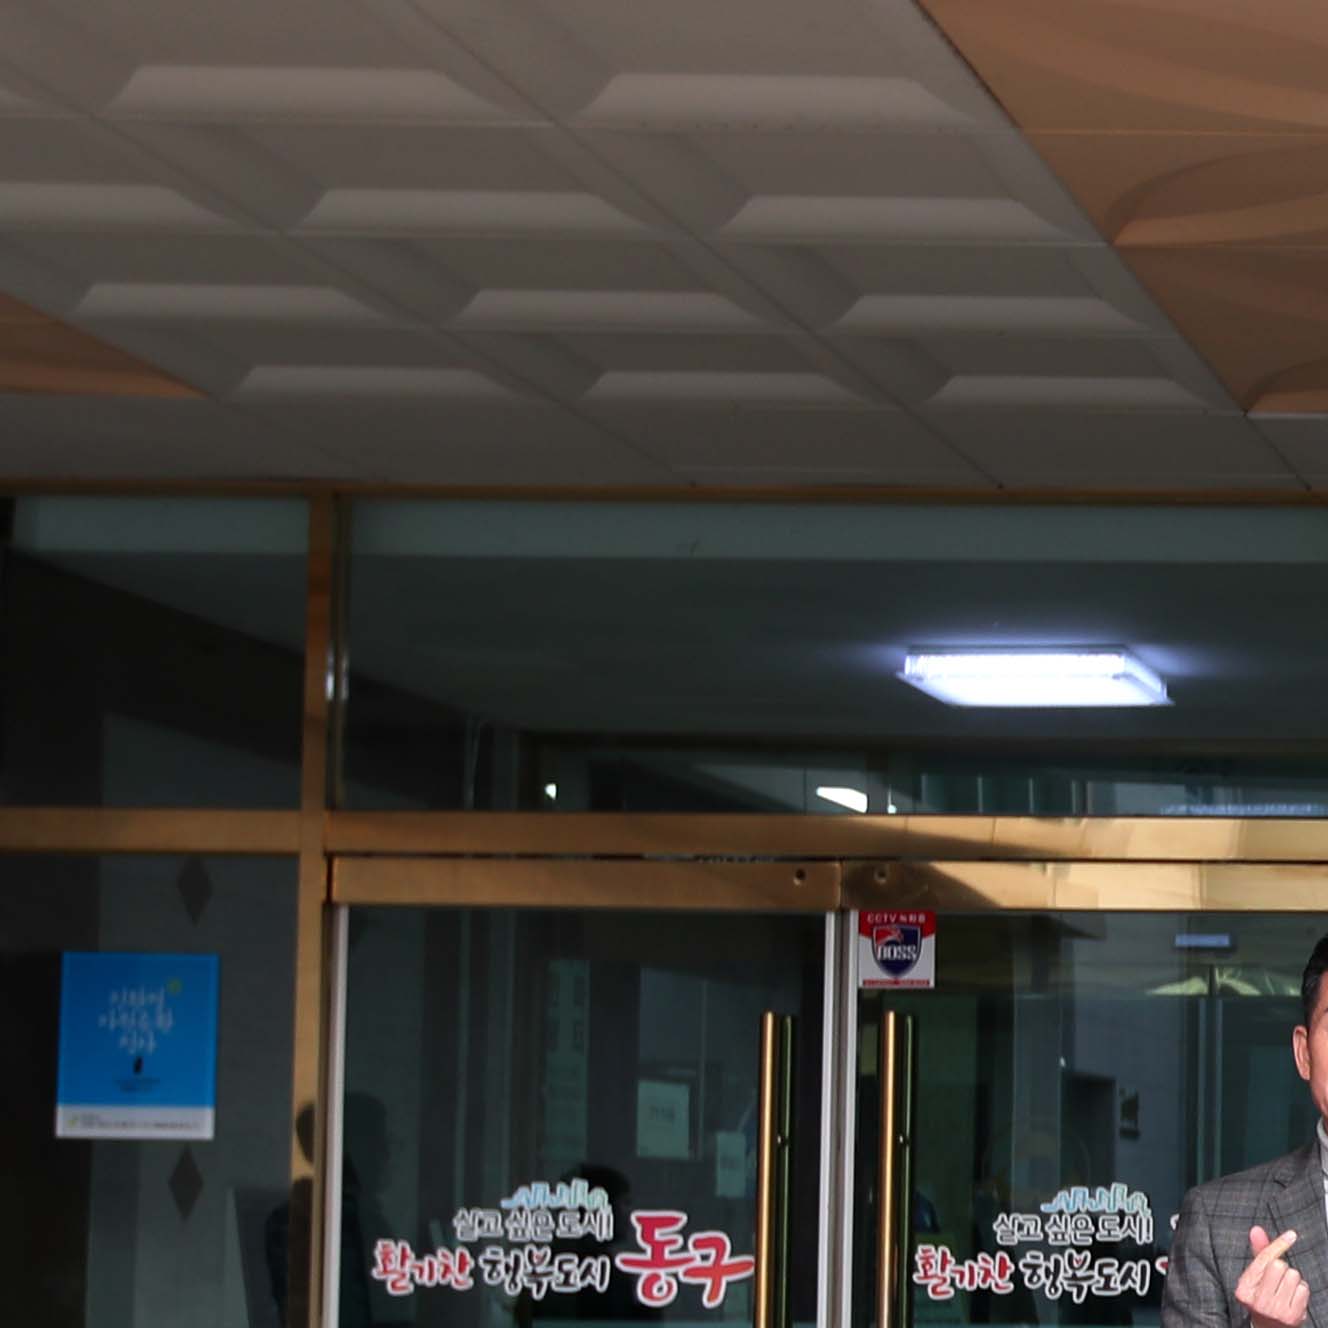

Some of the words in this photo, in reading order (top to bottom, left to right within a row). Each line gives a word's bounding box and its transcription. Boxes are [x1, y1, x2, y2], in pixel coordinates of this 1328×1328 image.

[994, 1213, 1041, 1244] 살고
[1047, 1213, 1094, 1244] 싶은
[1098, 1213, 1153, 1244] 도시!
[372, 1239, 474, 1295] 활기찬
[479, 1243, 610, 1300] 행복도시
[616, 1210, 755, 1308] 동구
[913, 1244, 1015, 1299] 활기찬
[1023, 1249, 1150, 1303] 행복도시
